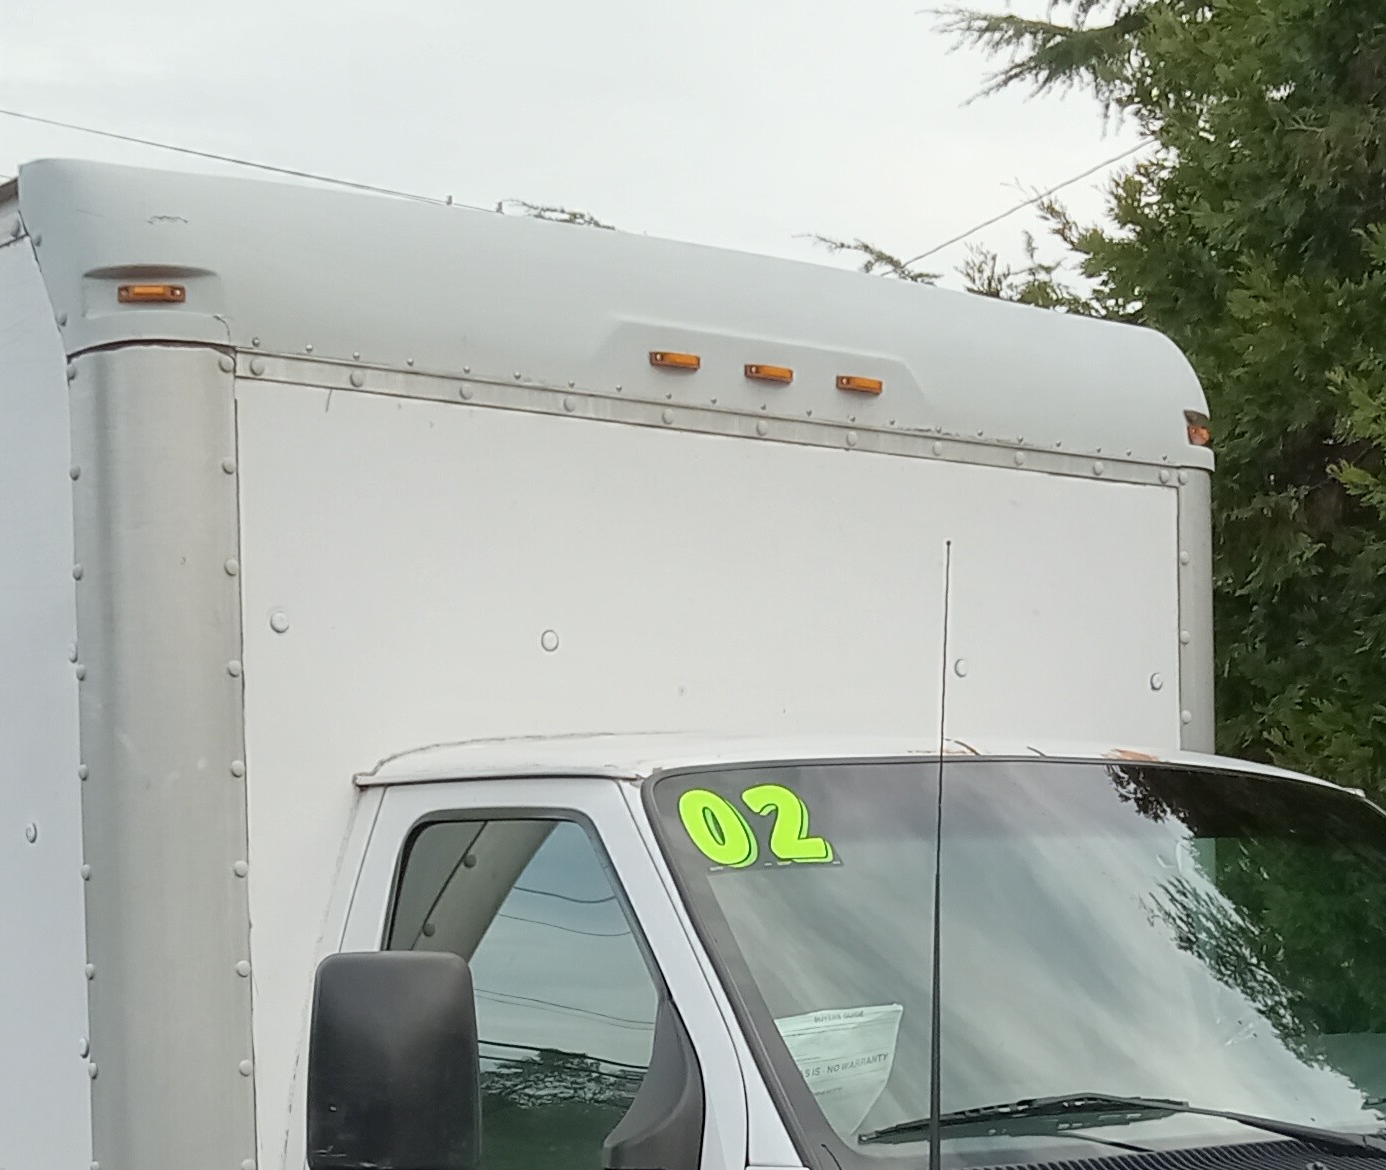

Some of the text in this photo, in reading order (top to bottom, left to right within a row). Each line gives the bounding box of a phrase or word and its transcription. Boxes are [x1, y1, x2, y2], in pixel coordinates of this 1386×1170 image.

[678, 784, 834, 868] 02
[842, 1010, 865, 1019] GUIDE
[826, 1064, 840, 1074] NO
[840, 1053, 889, 1069] WARRANTY
